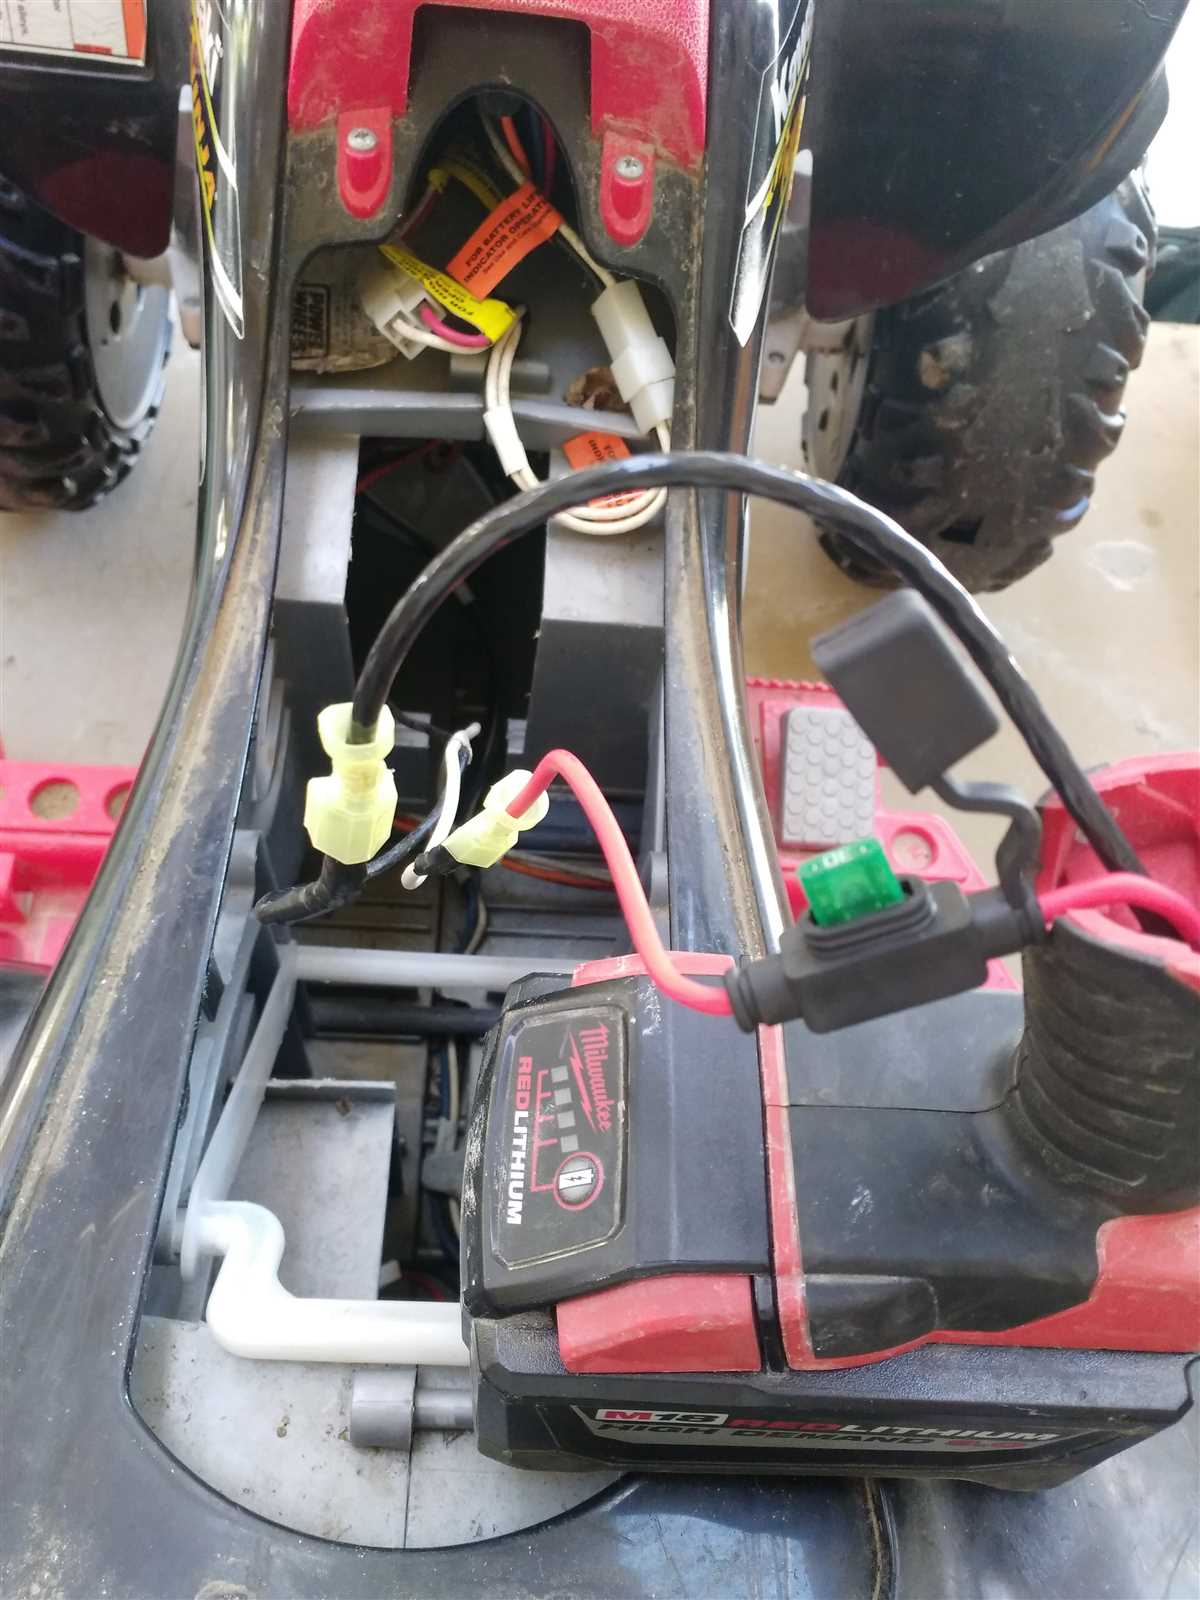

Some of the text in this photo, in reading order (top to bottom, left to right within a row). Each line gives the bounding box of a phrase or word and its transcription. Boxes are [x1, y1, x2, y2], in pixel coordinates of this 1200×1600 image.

[462, 232, 509, 283] INDICATOR
[464, 245, 483, 267] FOR
[481, 205, 522, 246] BATTERY
[579, 1023, 615, 1135] Milwaukee
[507, 1056, 533, 1225] REDLITHIUM
[597, 1423, 721, 1435] HIGH
[731, 1430, 935, 1444] DEMAND
[603, 1410, 720, 1423] M18
